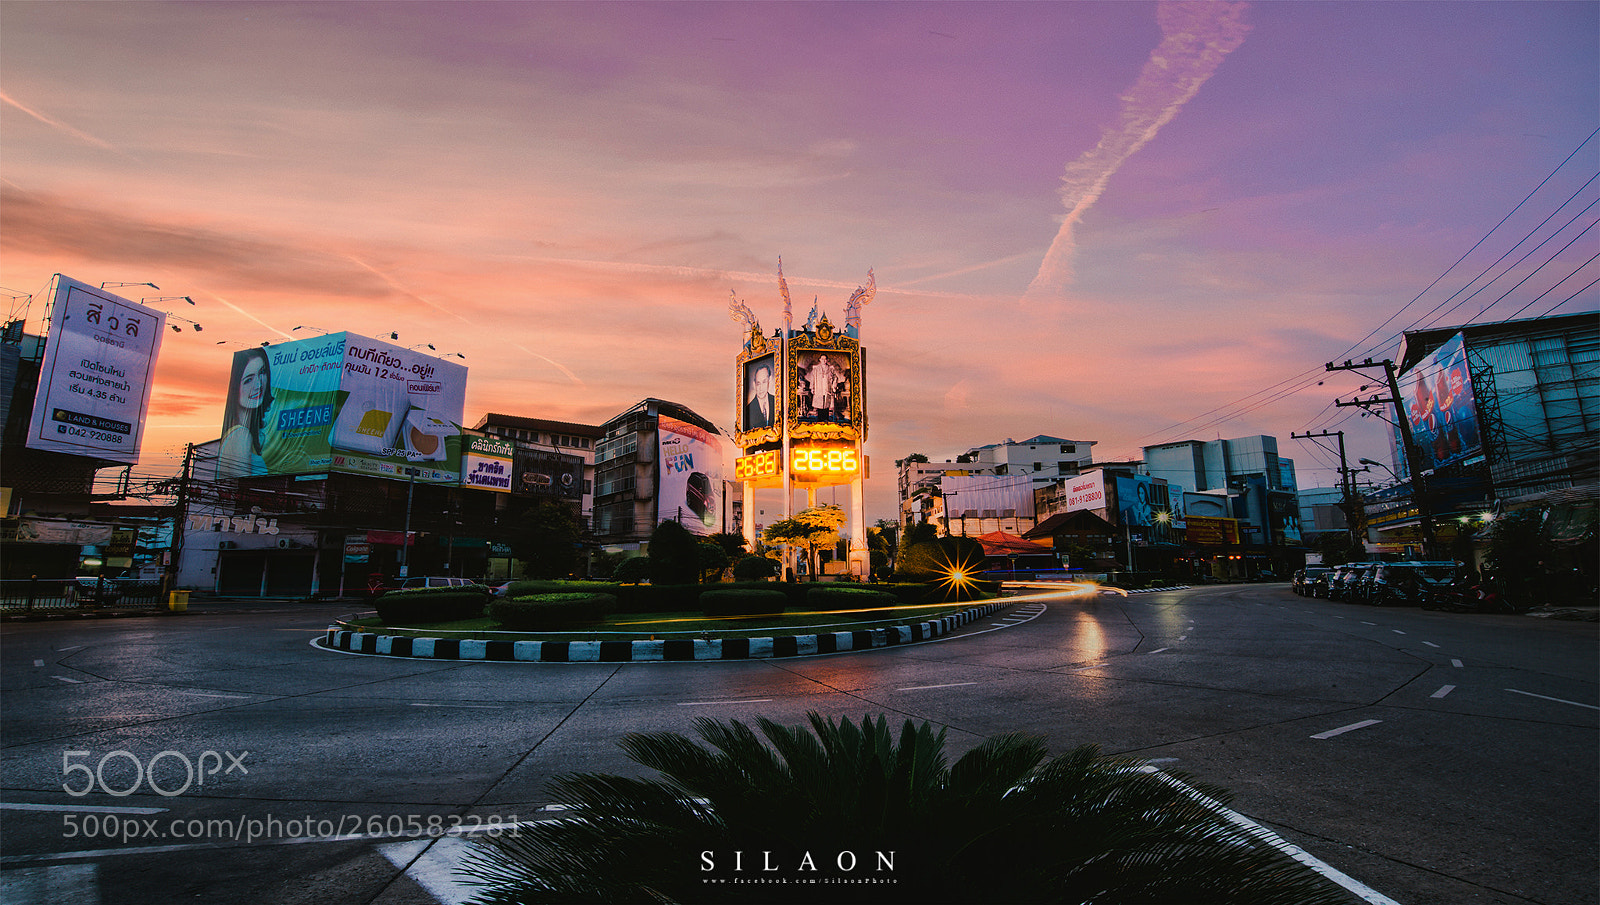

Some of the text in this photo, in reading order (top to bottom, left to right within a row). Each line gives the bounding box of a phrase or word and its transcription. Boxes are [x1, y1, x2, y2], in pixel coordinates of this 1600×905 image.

[86, 303, 141, 337] สีวลี
[80, 359, 126, 378] เปิดโซนใหม่
[344, 362, 371, 375] คุมมัน
[374, 367, 388, 379] 12
[69, 370, 131, 392] สวนแห่งสายน้ำ
[69, 383, 126, 404] เริ่ม 4.35 ล้าน
[67, 413, 129, 432] LAND & HOUSES
[68, 426, 123, 444] 042 920888
[381, 447, 397, 456] SPF
[662, 444, 689, 457] HELLO
